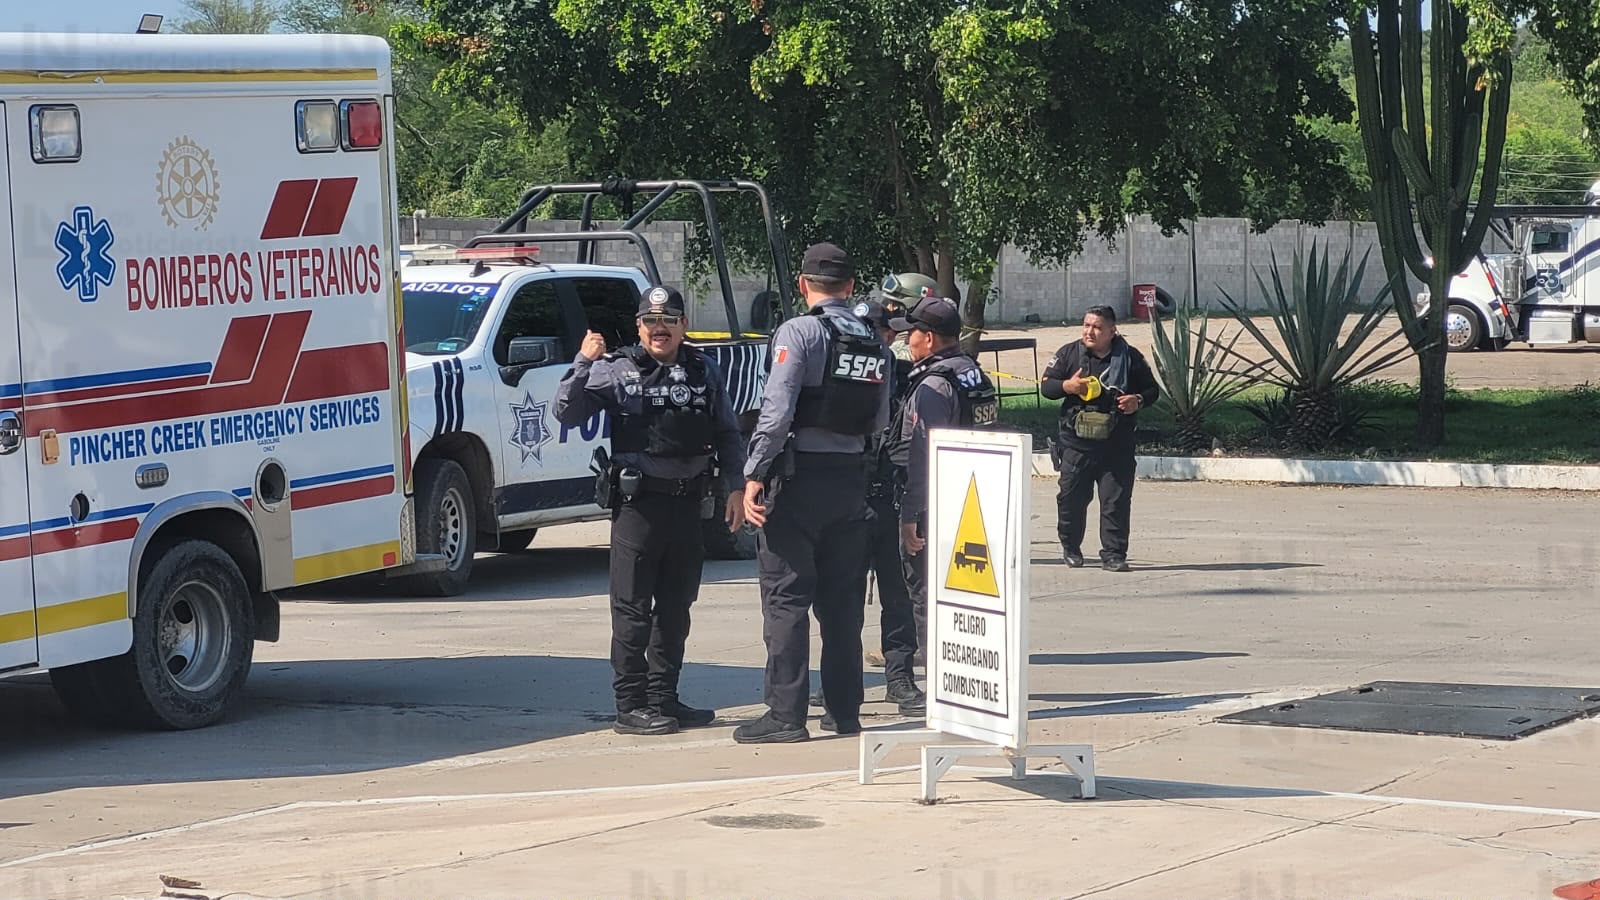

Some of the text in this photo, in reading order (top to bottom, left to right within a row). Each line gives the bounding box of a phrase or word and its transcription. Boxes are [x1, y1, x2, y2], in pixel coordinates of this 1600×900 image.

[126, 244, 381, 311] BOMBEROS VETERANOS
[1535, 268, 1560, 288] 53
[835, 353, 886, 380] SSPC
[69, 395, 381, 466] PINCHER CREEK EMERGENCY SERVICES
[953, 612, 986, 637] PELIGRO
[942, 640, 1000, 671] DESCARGANDO
[943, 671, 999, 703] COMBUSTIBLE
